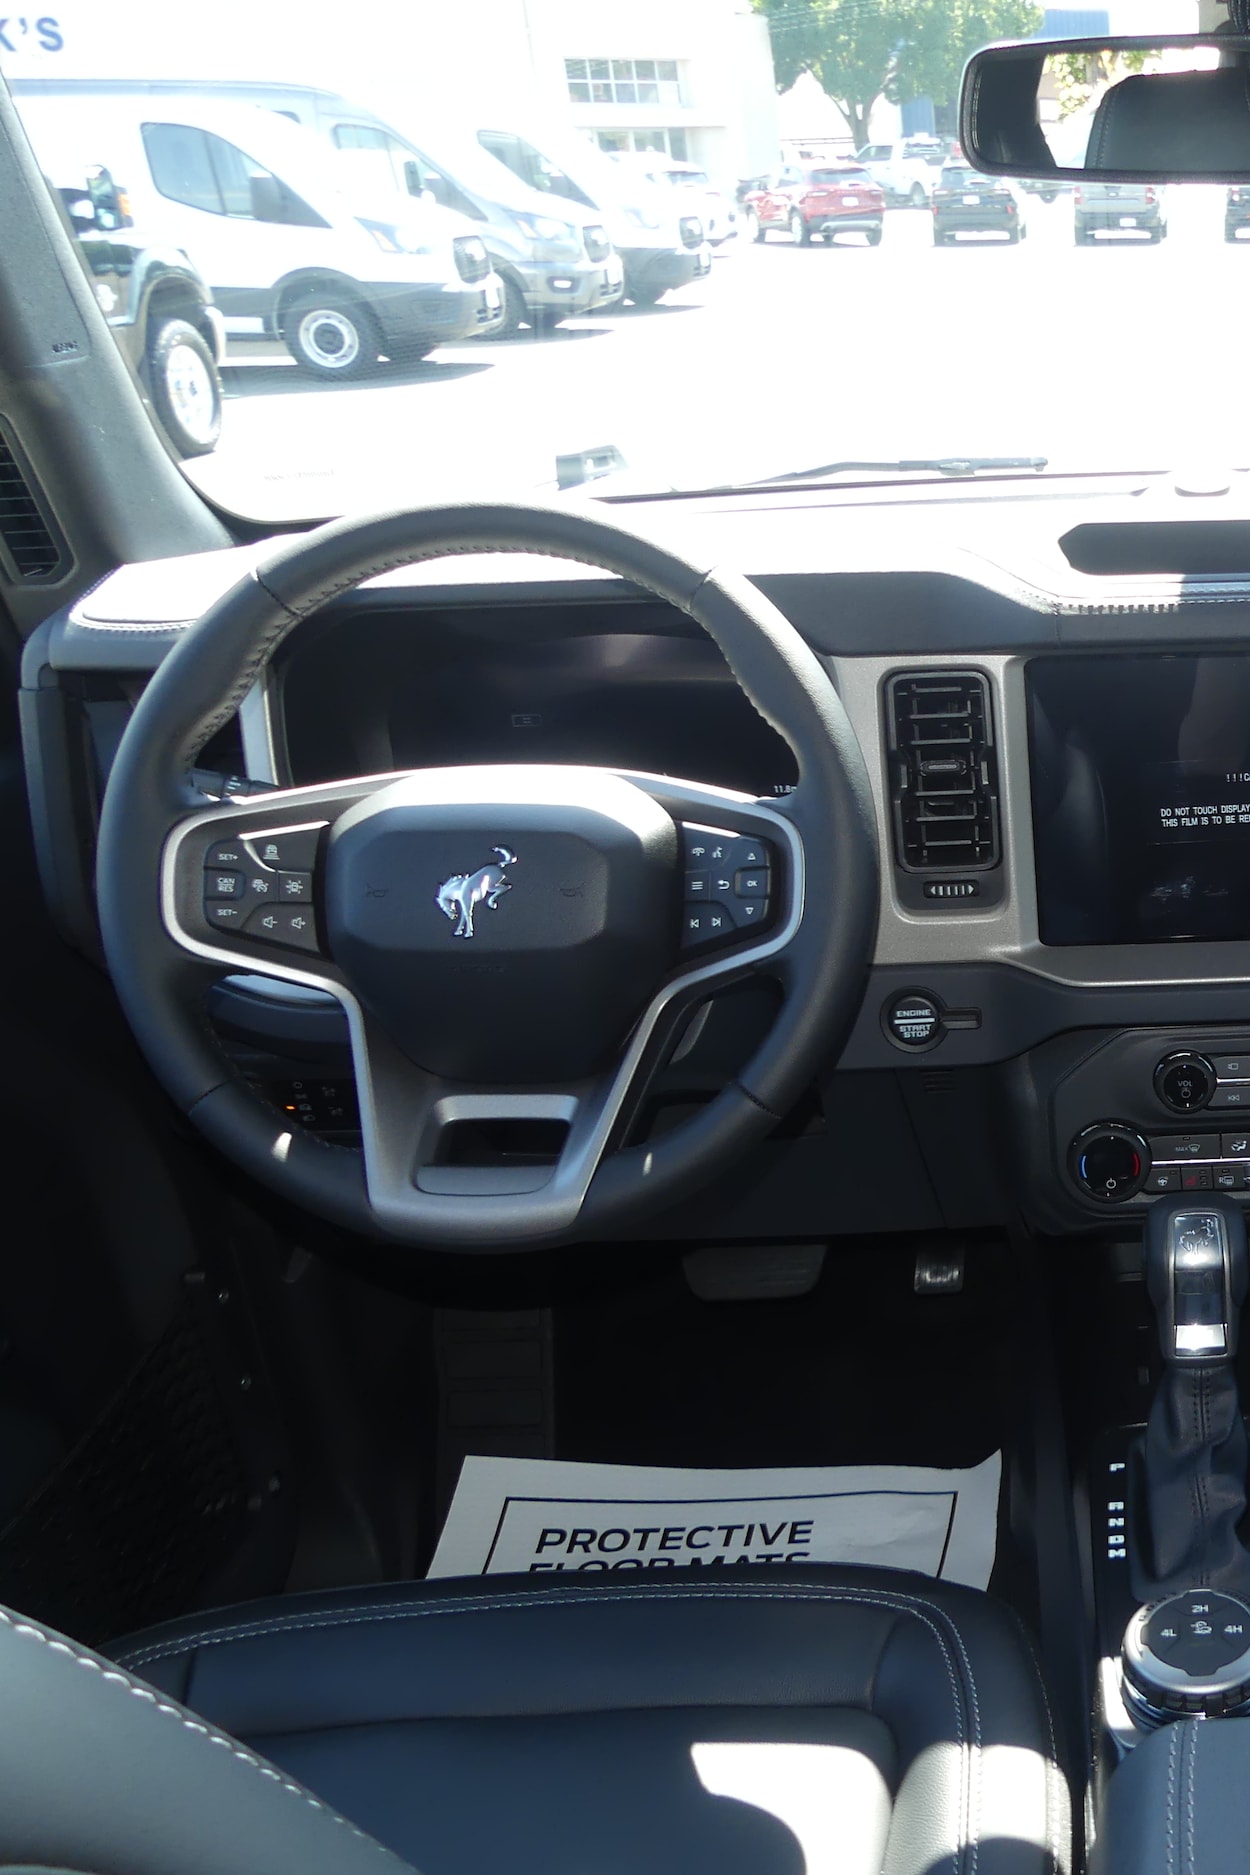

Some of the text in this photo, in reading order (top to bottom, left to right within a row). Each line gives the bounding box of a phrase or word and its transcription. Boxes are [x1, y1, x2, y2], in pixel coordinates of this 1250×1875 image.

[1161, 808, 1172, 817] DO
[1175, 807, 1190, 816] NOT
[1193, 806, 1218, 815] TOUCH
[1221, 804, 1250, 814] DISPLAY
[1162, 818, 1178, 827] THIS
[1181, 817, 1198, 826] FILM
[1201, 816, 1209, 825] IS
[1212, 816, 1223, 824] TO
[1225, 815, 1236, 824] BE
[218, 884, 234, 892] RES
[896, 1009, 931, 1018] ENGINE
[900, 1024, 932, 1033] START
[904, 1030, 930, 1039] STOP
[1109, 1463, 1125, 1472] P
[1108, 1517, 1125, 1527] N
[535, 1520, 814, 1554] PROTECTIVE
[1108, 1534, 1125, 1544] D
[1108, 1548, 1126, 1558] M
[1191, 1604, 1209, 1613] 2H
[1160, 1625, 1243, 1637] 4L 4H
